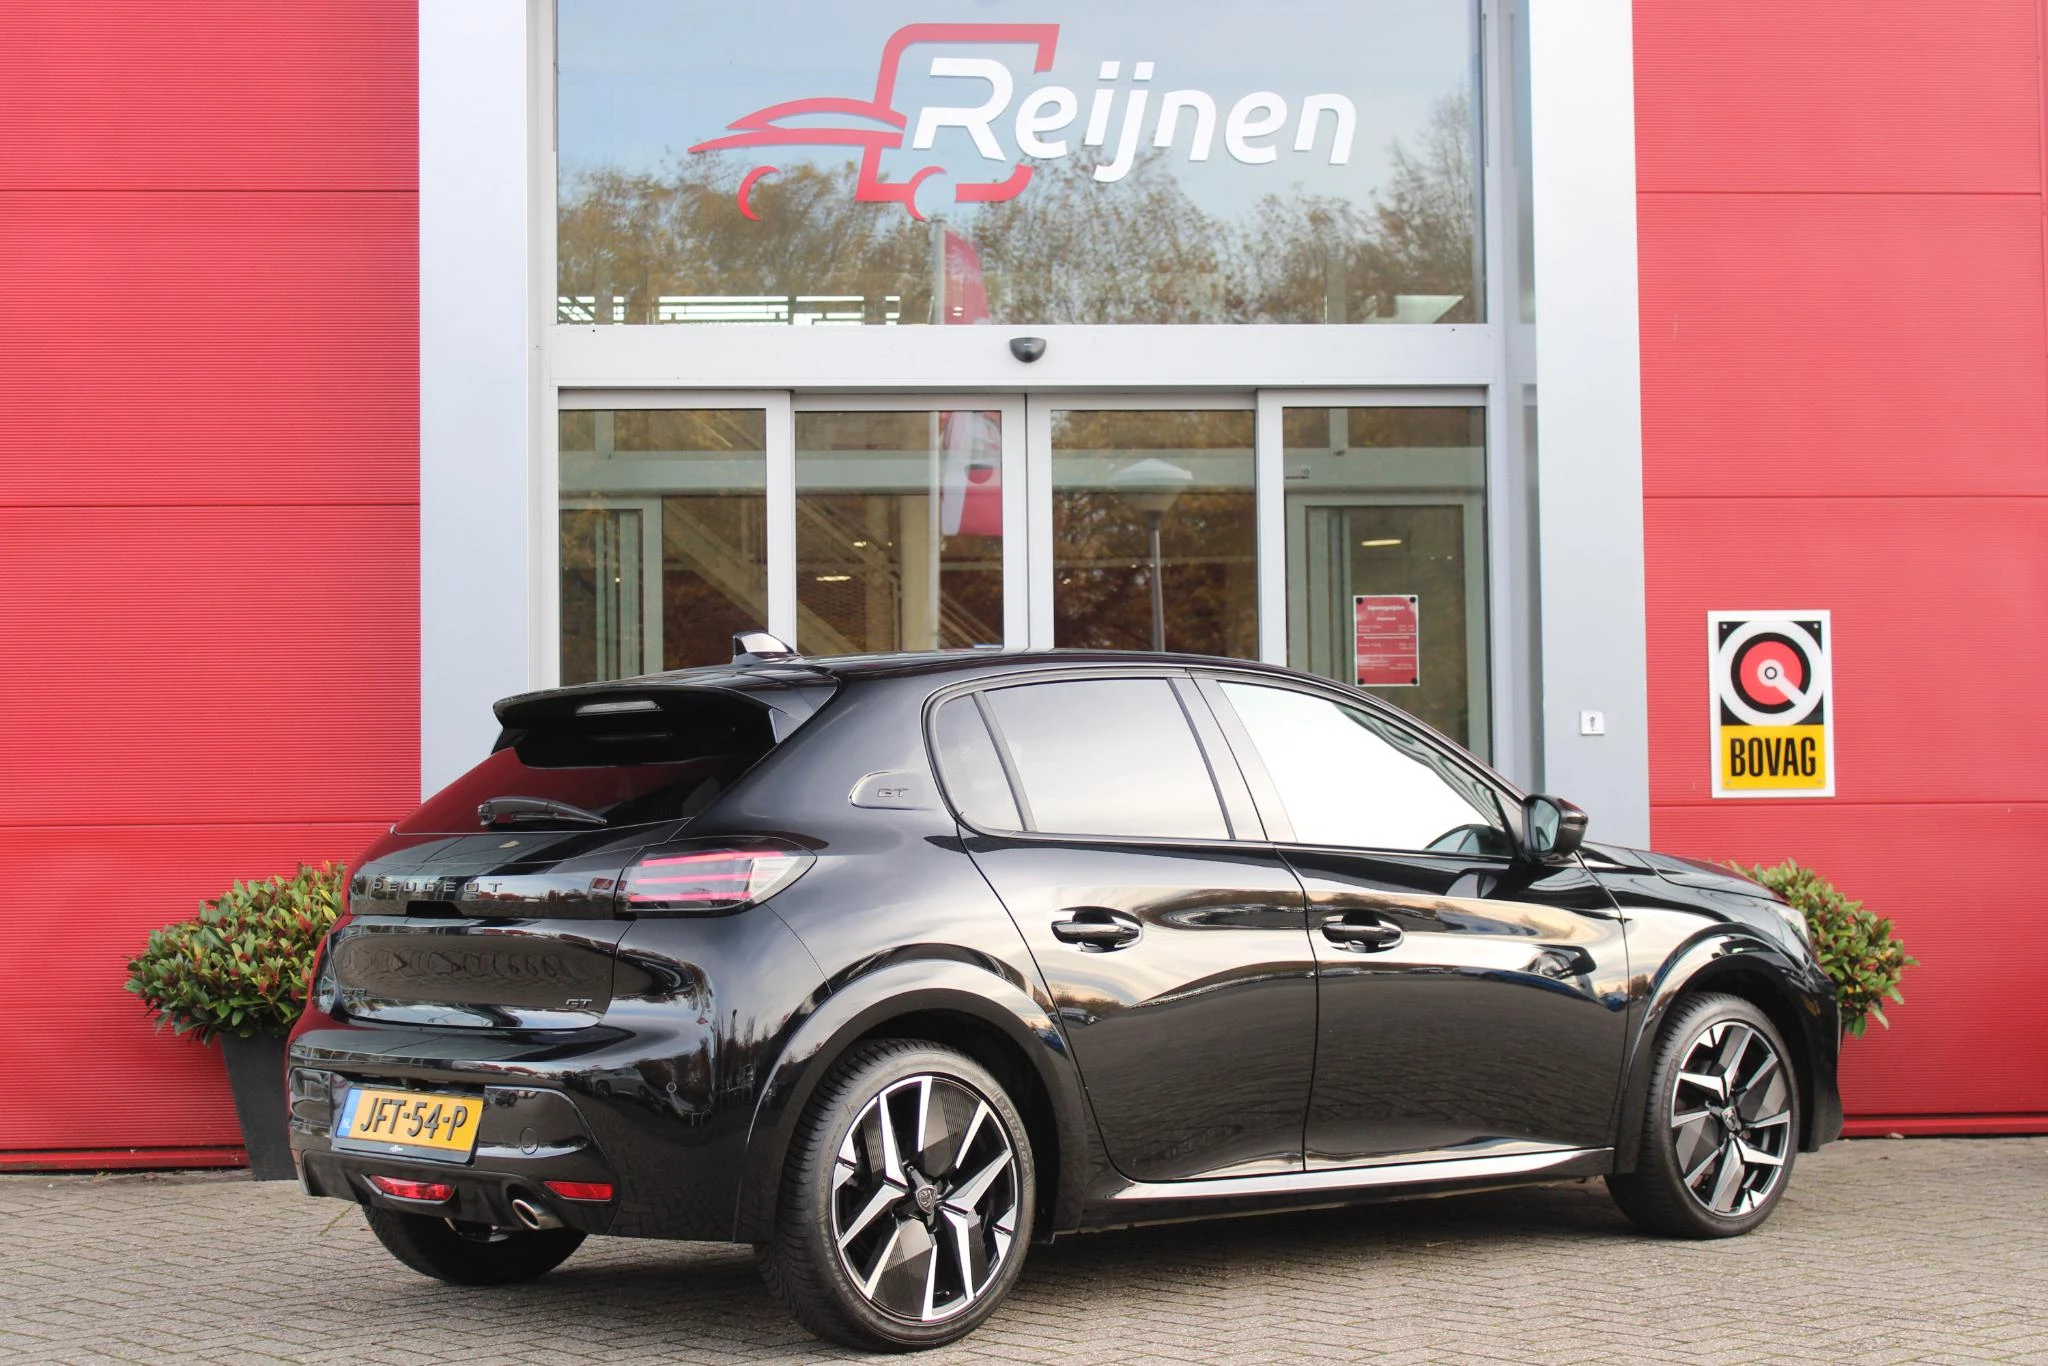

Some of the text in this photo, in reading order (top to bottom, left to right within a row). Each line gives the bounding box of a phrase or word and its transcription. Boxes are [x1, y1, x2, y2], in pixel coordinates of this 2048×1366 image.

[912, 57, 1357, 183] Reijnen
[1730, 736, 1816, 777] BOVAG
[372, 881, 503, 894] PEUGEOT
[359, 1097, 468, 1141] JFT-54-P
